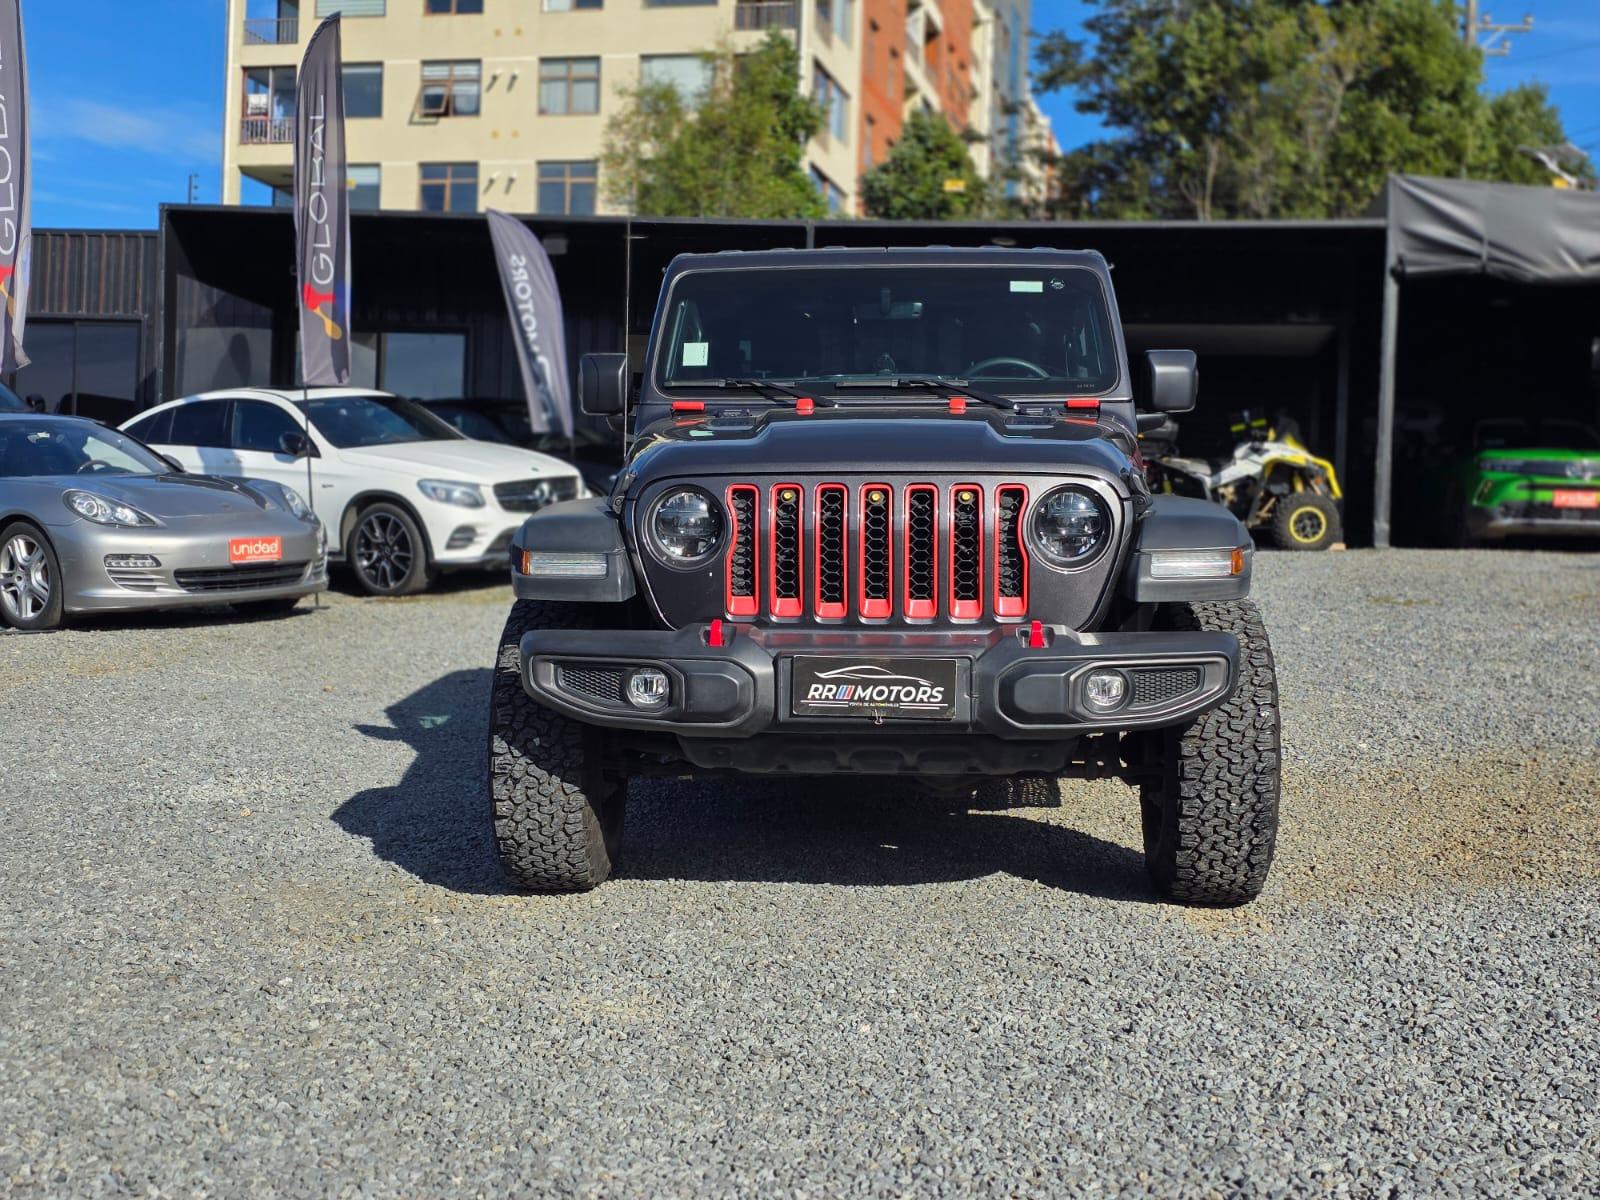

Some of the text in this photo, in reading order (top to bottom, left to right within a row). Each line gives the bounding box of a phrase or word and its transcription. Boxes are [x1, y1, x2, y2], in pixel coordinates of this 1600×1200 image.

[309, 94, 334, 285] GLOBAL
[232, 539, 279, 555] unidad
[853, 685, 945, 703] MOTORS
